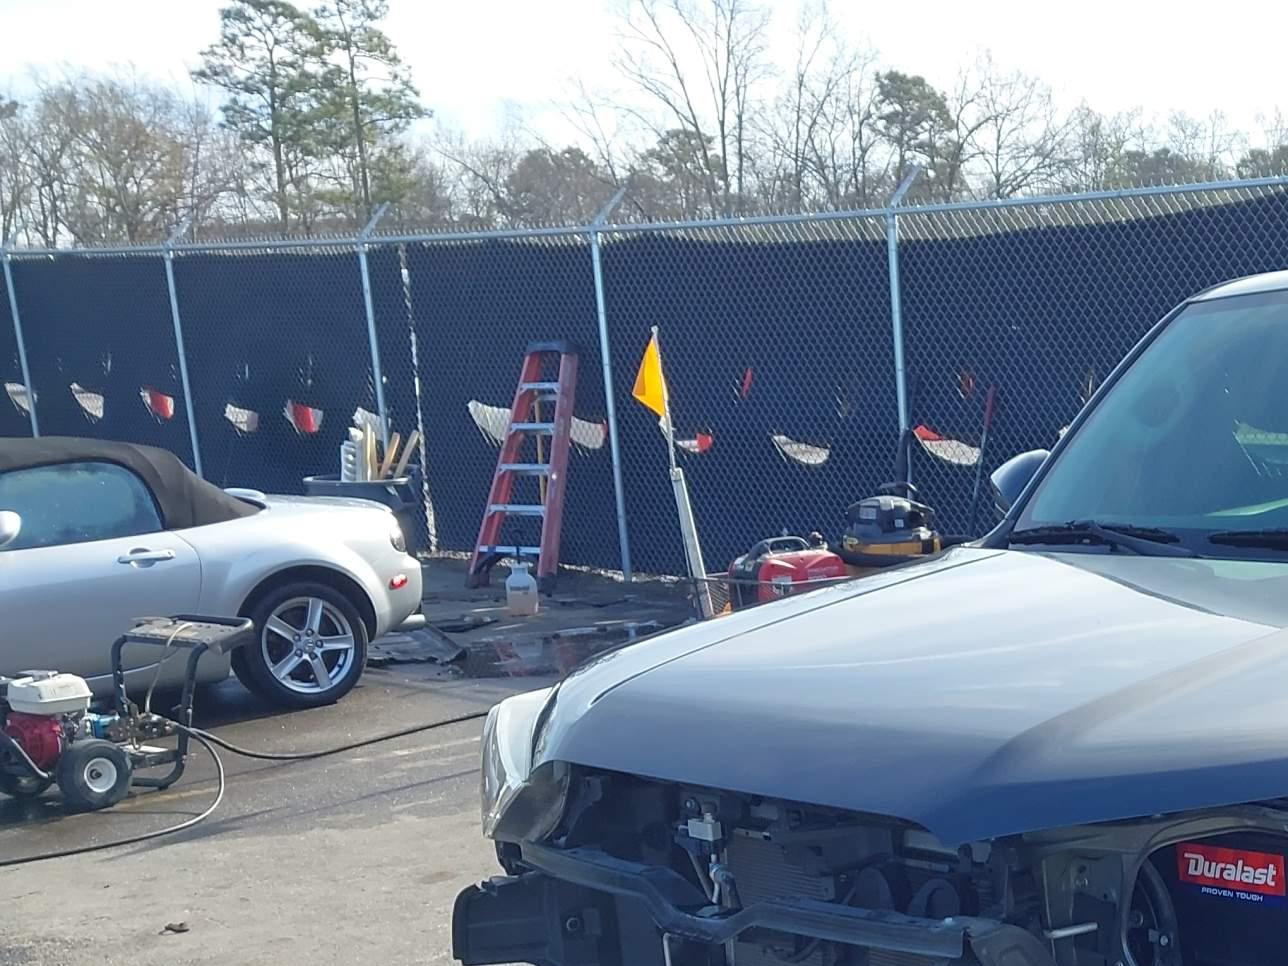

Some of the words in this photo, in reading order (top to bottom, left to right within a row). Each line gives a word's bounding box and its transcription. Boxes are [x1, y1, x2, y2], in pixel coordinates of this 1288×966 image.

[1184, 852, 1276, 886] Duralast
[1201, 887, 1233, 898] PROVEN
[1236, 892, 1263, 902] TOUGH
